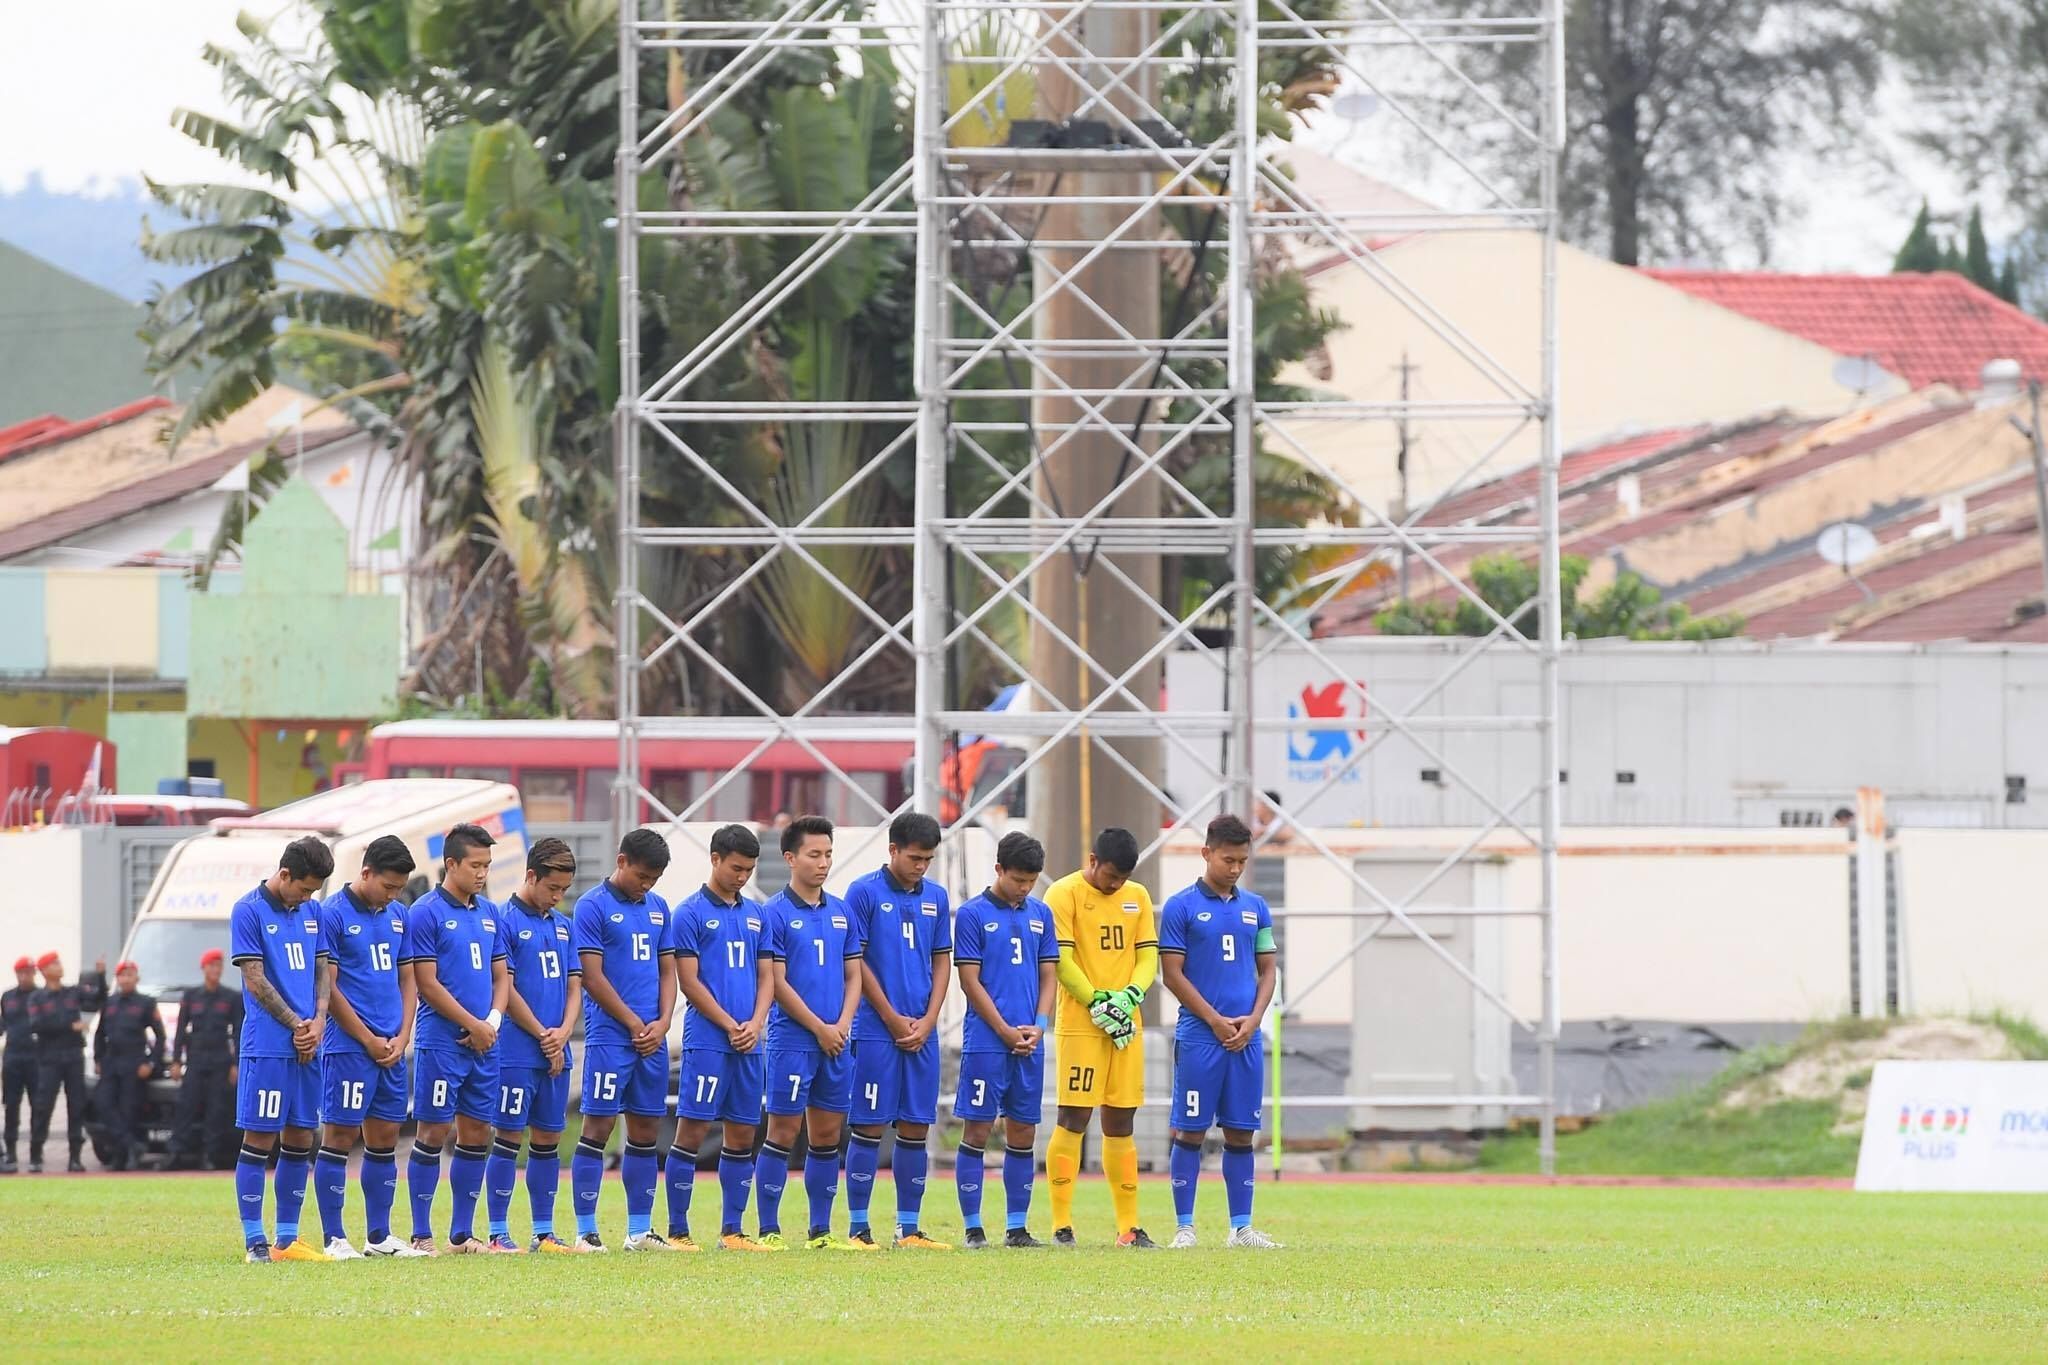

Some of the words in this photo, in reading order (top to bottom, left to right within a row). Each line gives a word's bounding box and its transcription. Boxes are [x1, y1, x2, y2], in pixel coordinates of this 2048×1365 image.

[631, 933, 651, 961] 15
[902, 922, 915, 949] 4
[1099, 924, 1124, 951] 20
[1222, 934, 1235, 961] 9
[284, 942, 306, 970] 10
[369, 942, 393, 971] 16
[469, 942, 483, 970] 8
[538, 950, 561, 979] 13
[726, 941, 746, 968] 17
[1010, 937, 1023, 965] 3
[432, 1079, 448, 1107] 8
[593, 1071, 618, 1100] 15
[696, 1075, 719, 1103] 17
[789, 1074, 801, 1102] 7
[971, 1079, 986, 1107] 3
[1068, 1066, 1095, 1092] 20
[258, 1089, 282, 1119] 10
[342, 1080, 365, 1110] 16
[500, 1085, 524, 1115] 13
[865, 1082, 878, 1110] 4
[1186, 1090, 1200, 1117] 9
[1902, 1141, 1957, 1159] PLUS
